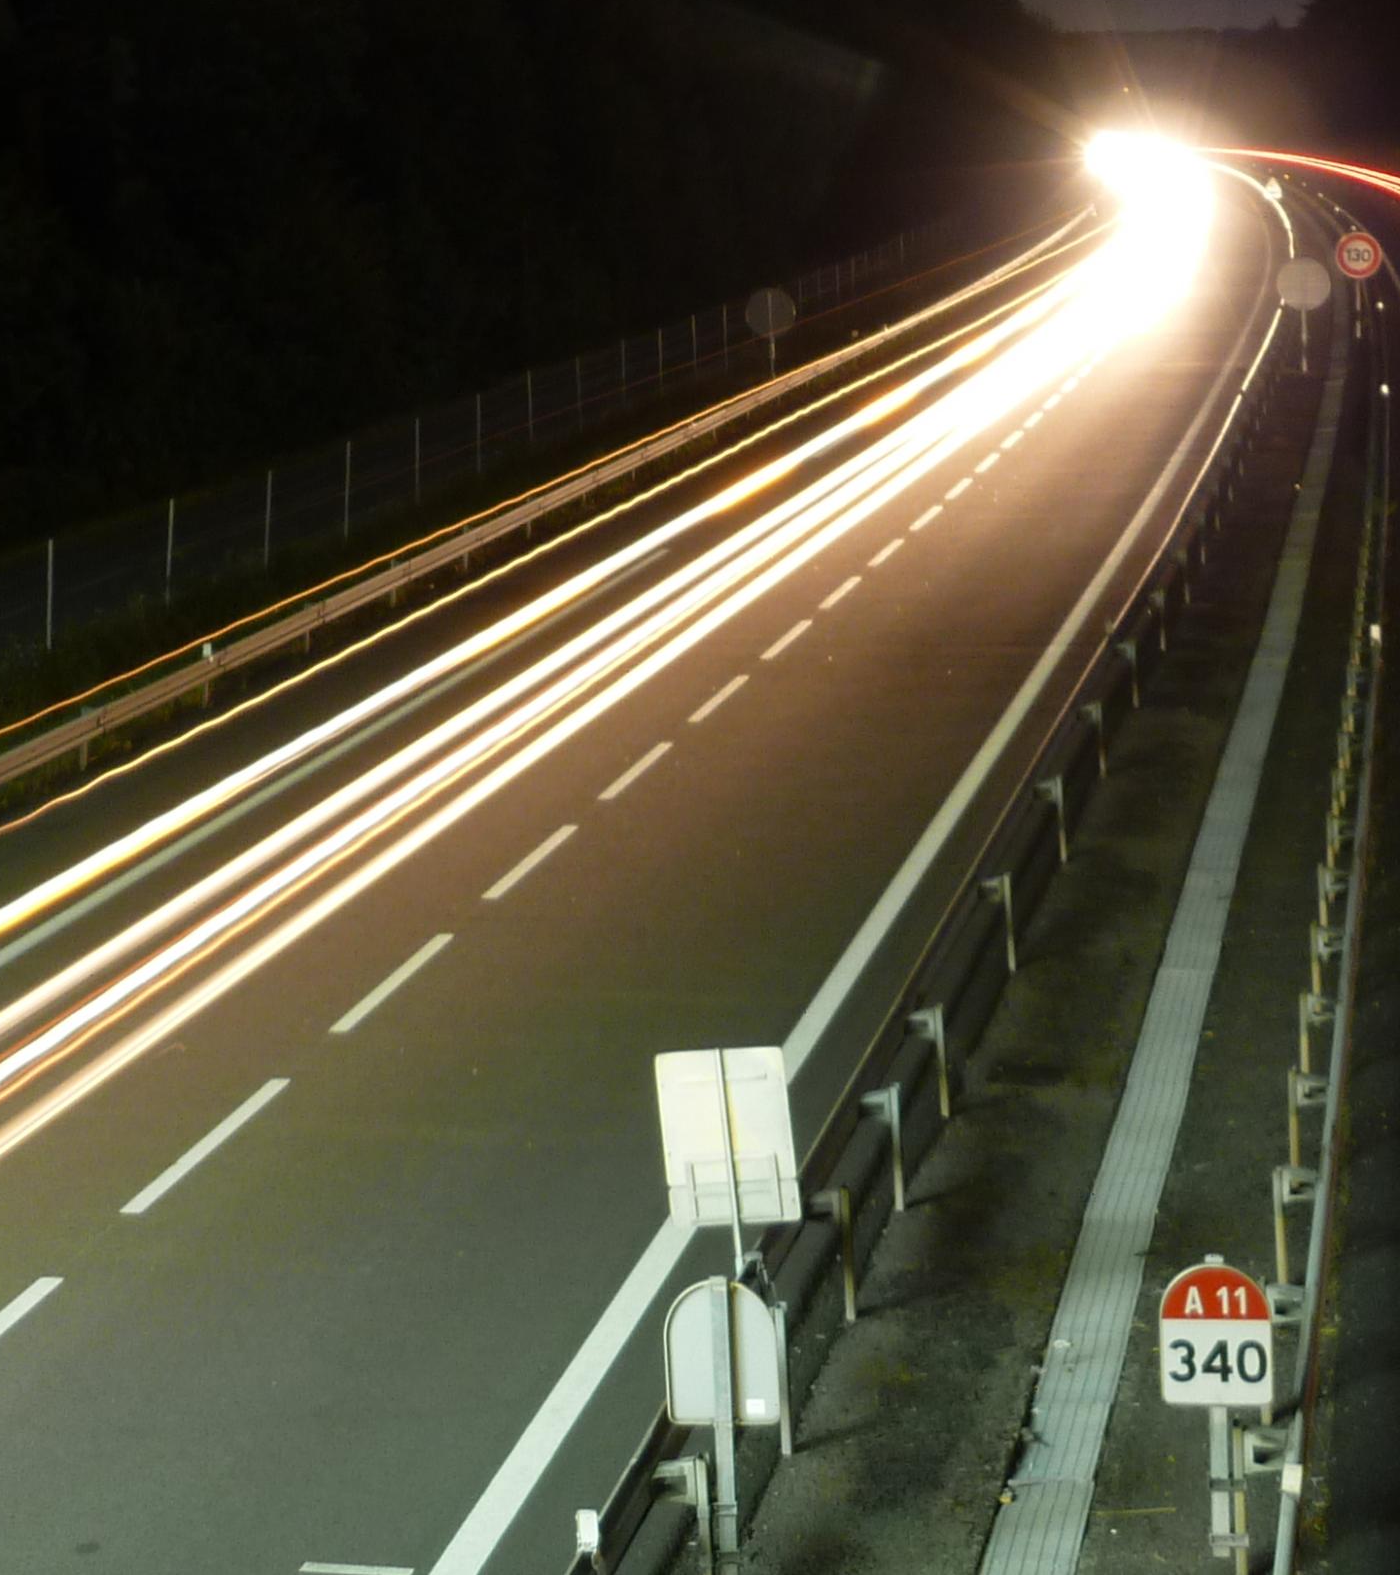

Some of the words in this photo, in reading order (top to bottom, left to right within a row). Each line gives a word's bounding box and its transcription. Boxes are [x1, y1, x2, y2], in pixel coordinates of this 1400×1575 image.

[1345, 248, 1372, 263] 130
[1184, 1285, 1203, 1316] A
[1216, 1285, 1249, 1316] 11
[1168, 1338, 1268, 1384] 340
